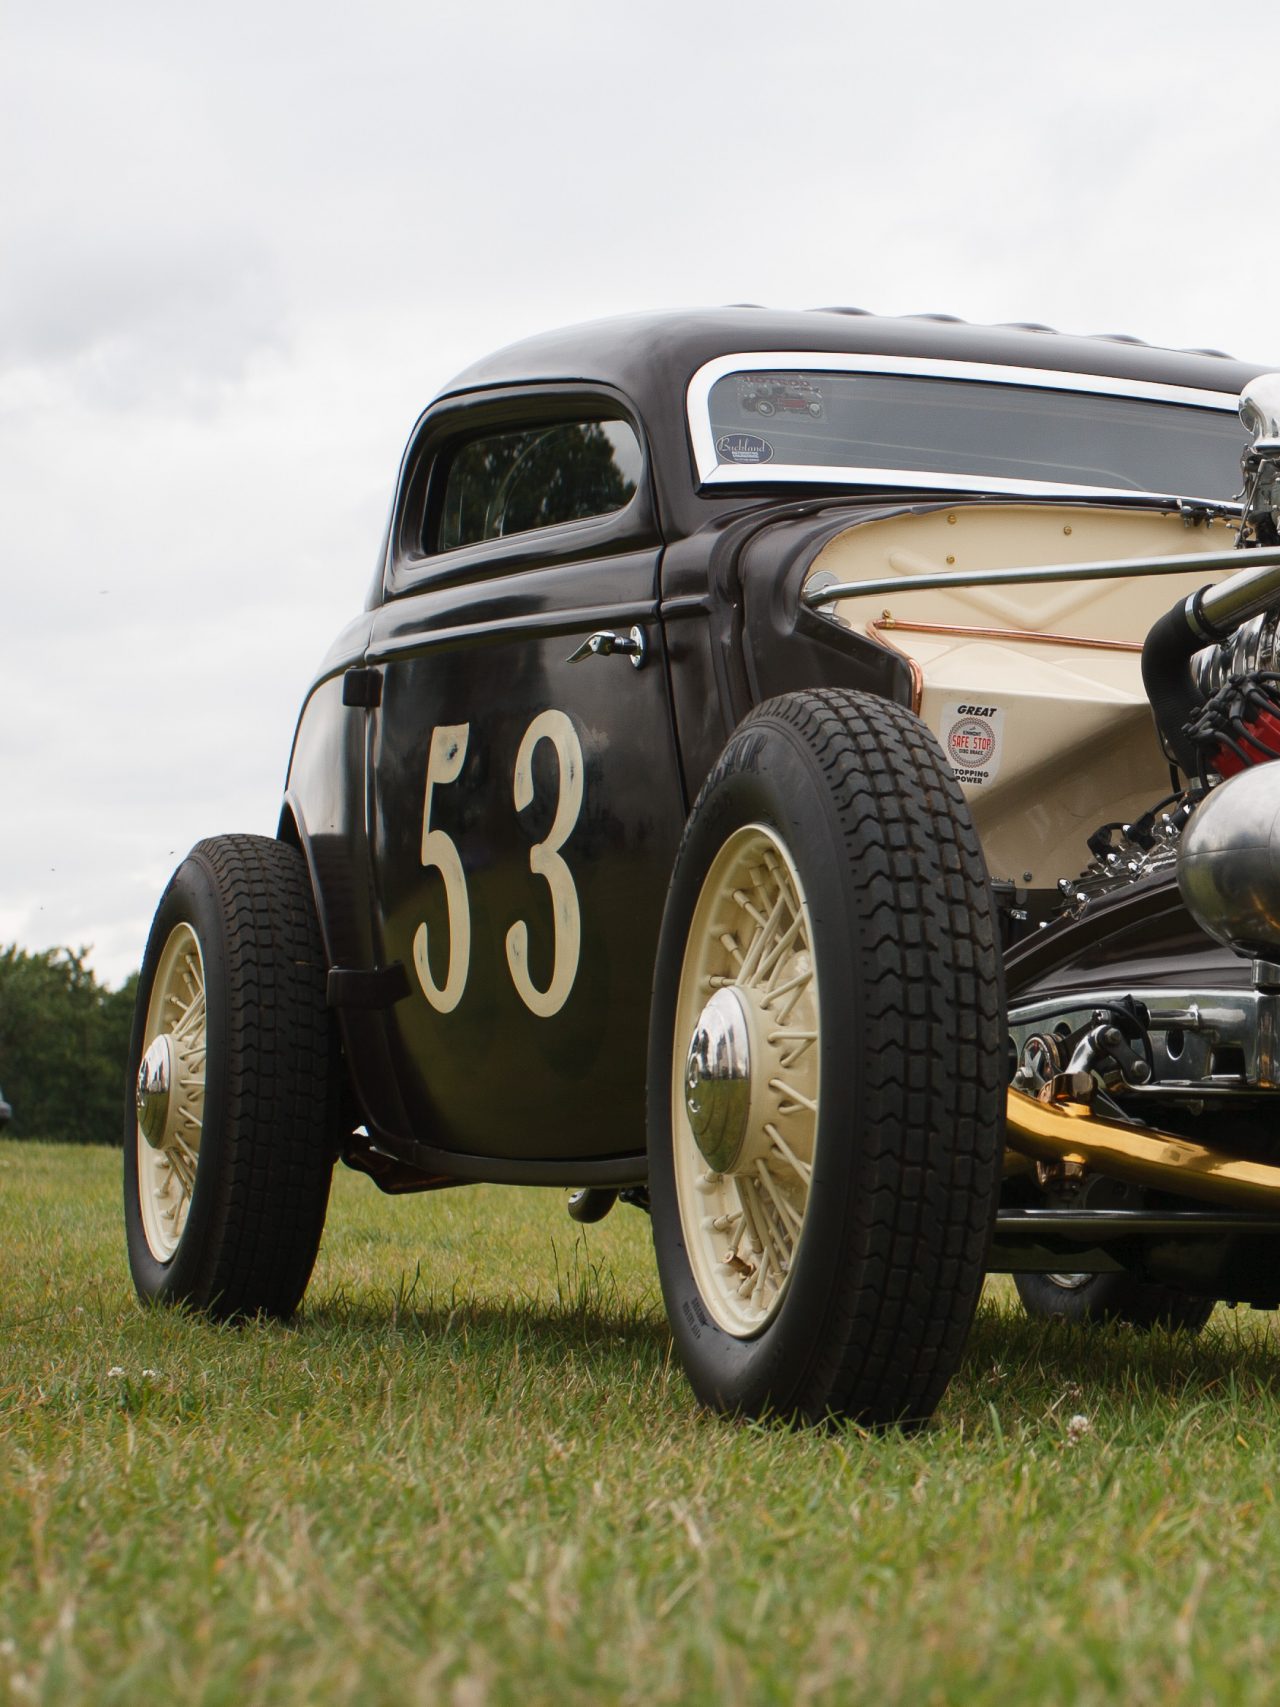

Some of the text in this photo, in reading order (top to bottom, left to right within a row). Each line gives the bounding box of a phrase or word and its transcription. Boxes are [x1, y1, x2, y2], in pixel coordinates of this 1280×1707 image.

[957, 705, 997, 717] GREAT
[952, 735, 992, 750] SAFE STOP
[956, 775, 983, 784] POWER
[413, 709, 584, 1018] 53
